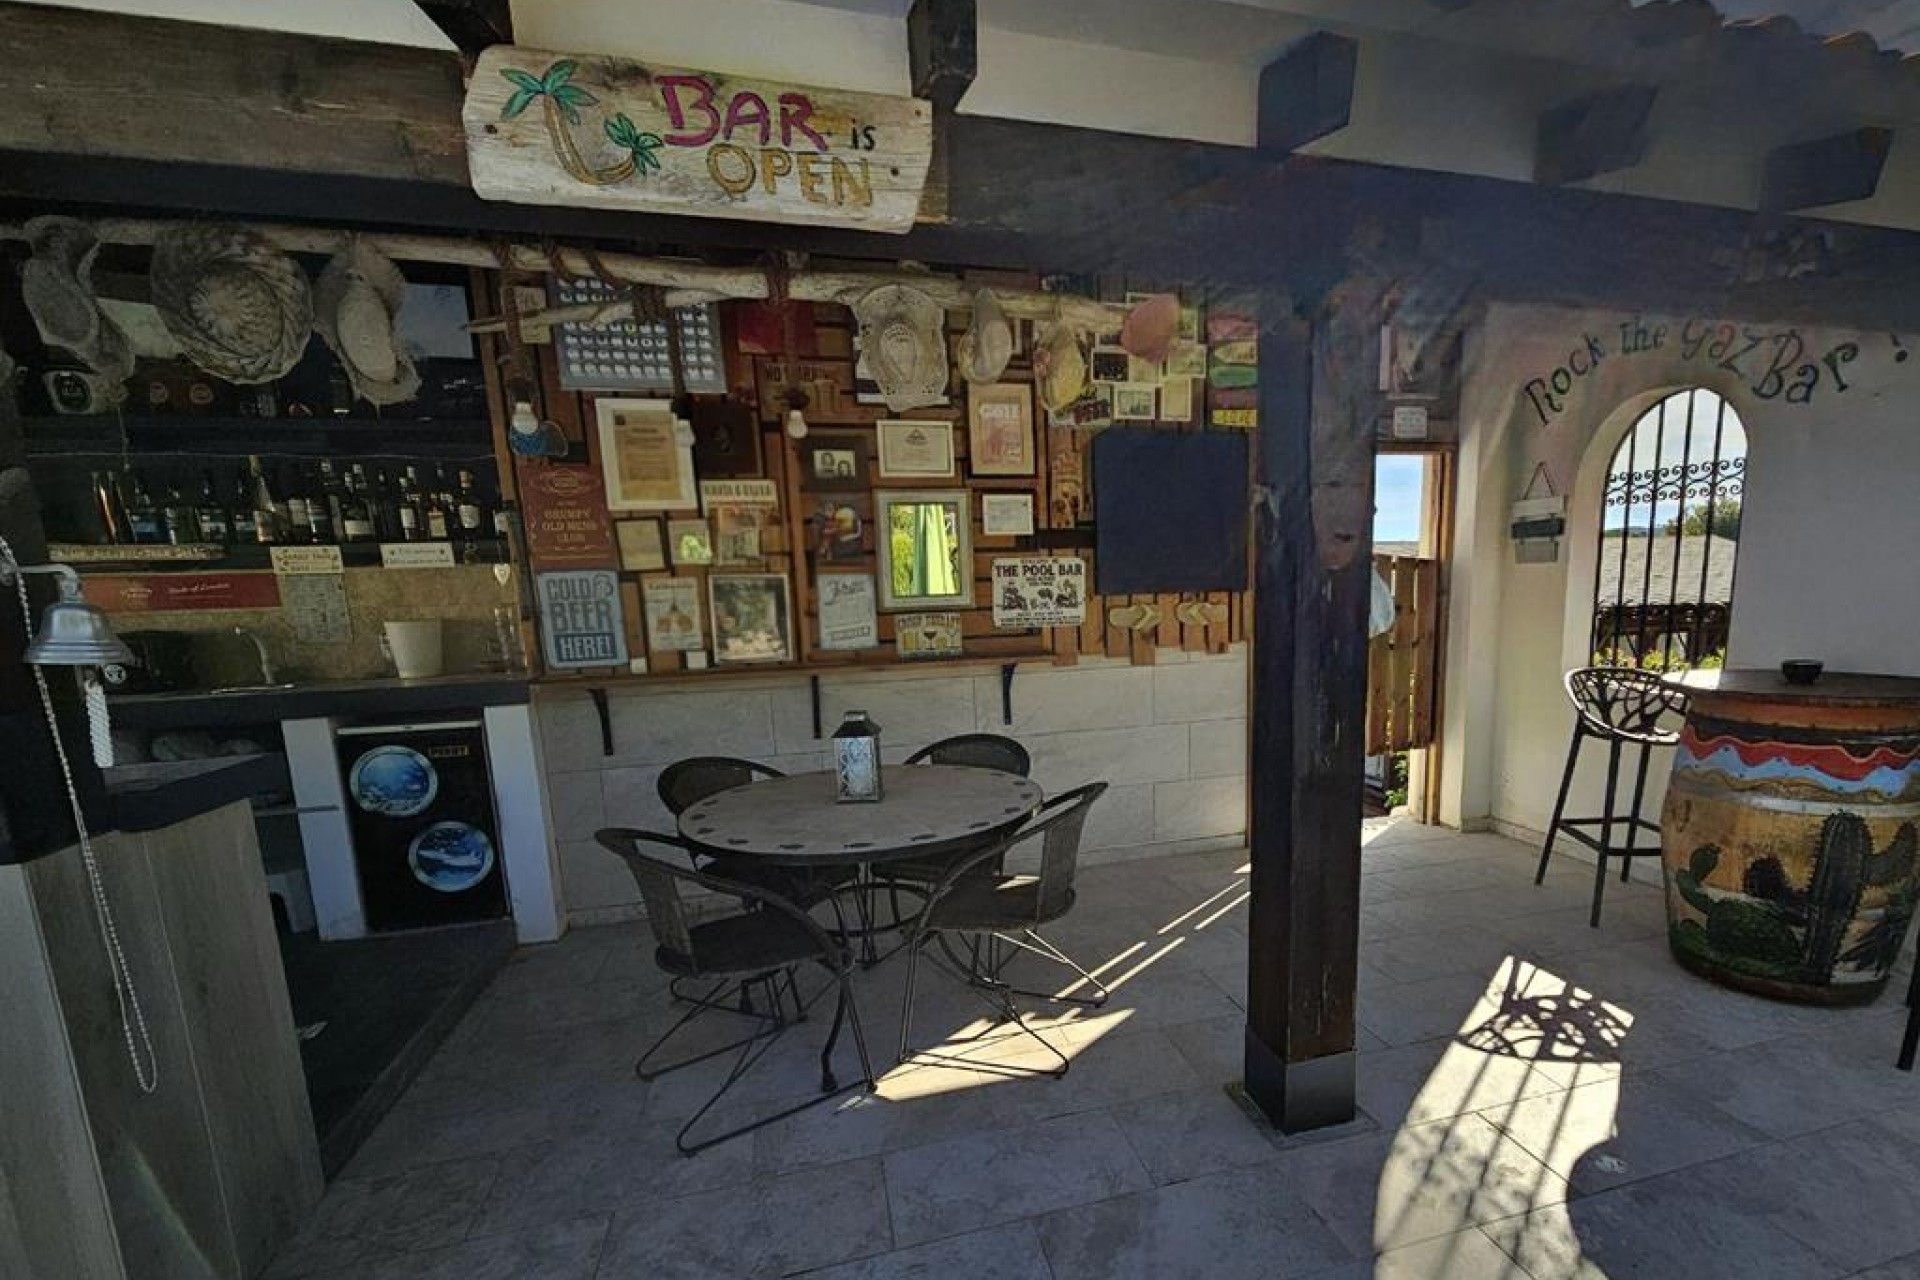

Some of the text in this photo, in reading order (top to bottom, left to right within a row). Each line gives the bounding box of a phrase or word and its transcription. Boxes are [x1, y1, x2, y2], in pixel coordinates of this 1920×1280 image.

[654, 74, 876, 151] BAR is
[706, 143, 873, 207] OPEN
[995, 565, 1018, 577] THE
[1022, 564, 1055, 576] POOL
[546, 578, 592, 602] COLD
[550, 601, 615, 632] BEER
[559, 635, 614, 660] HERE!
